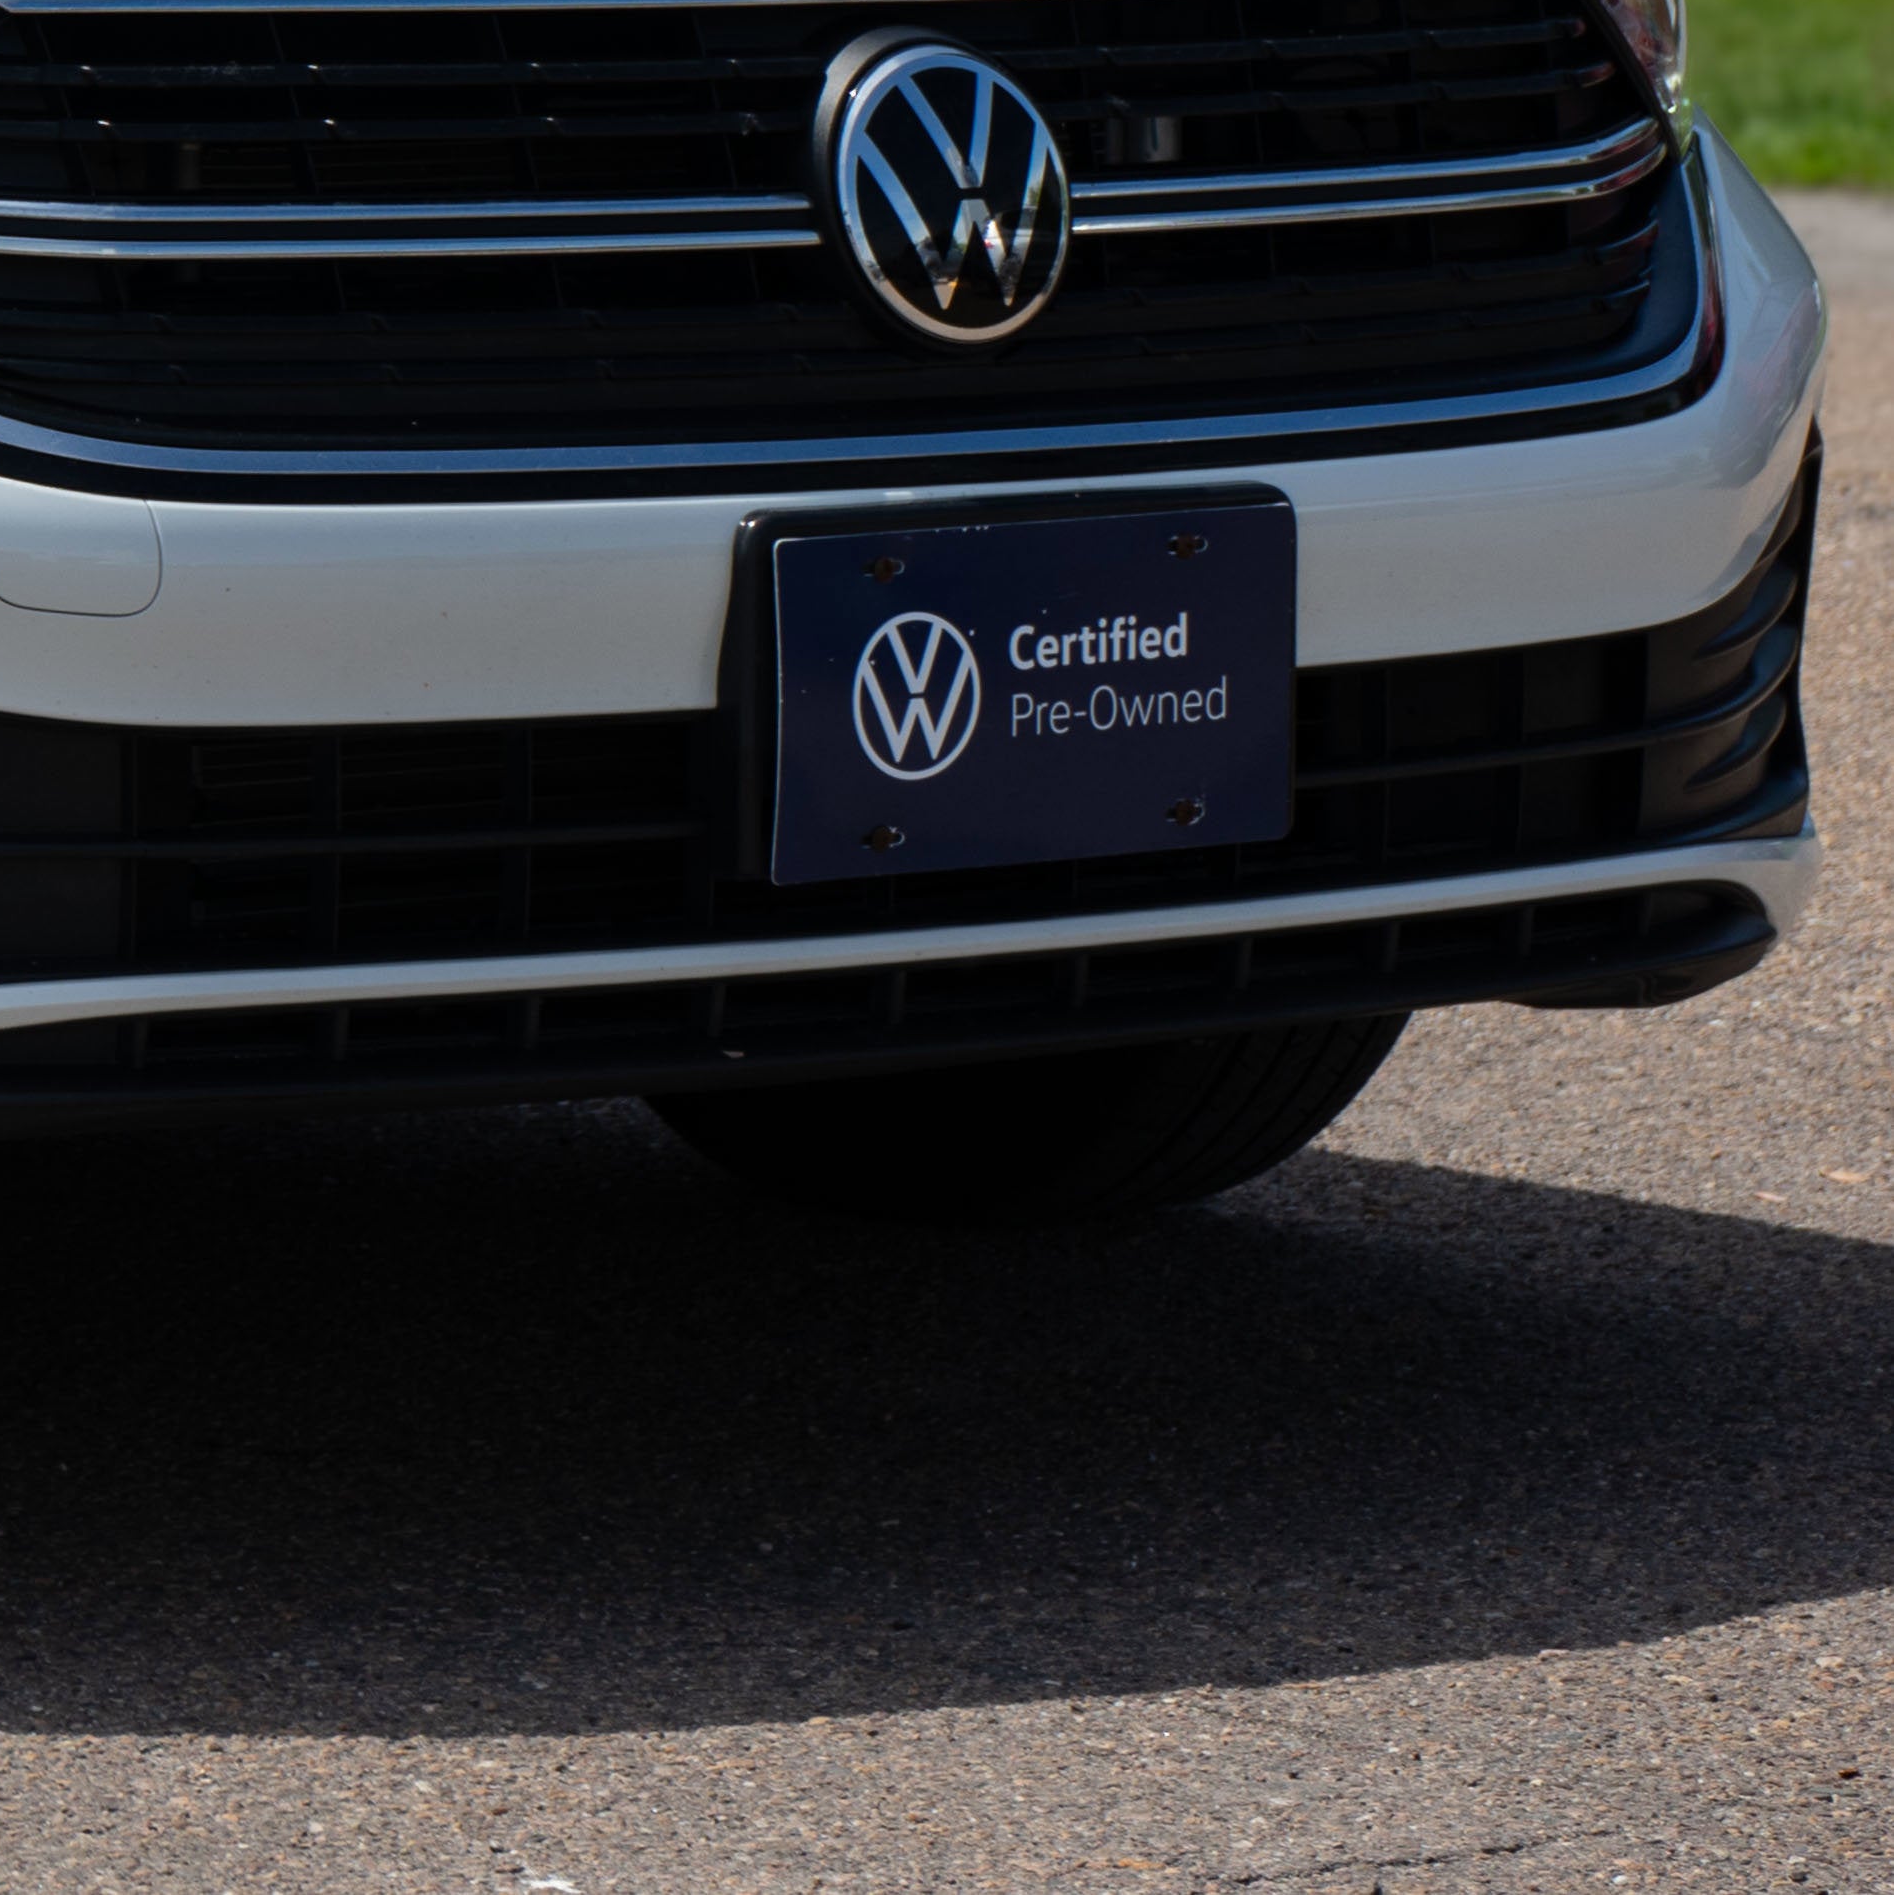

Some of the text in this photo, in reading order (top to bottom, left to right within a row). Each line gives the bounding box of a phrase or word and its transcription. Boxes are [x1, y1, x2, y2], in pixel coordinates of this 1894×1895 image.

[845, 56, 1059, 321] VW
[855, 614, 979, 774] VW
[1009, 612, 1189, 670] Certified
[1011, 675, 1228, 738] Pre-Owned
